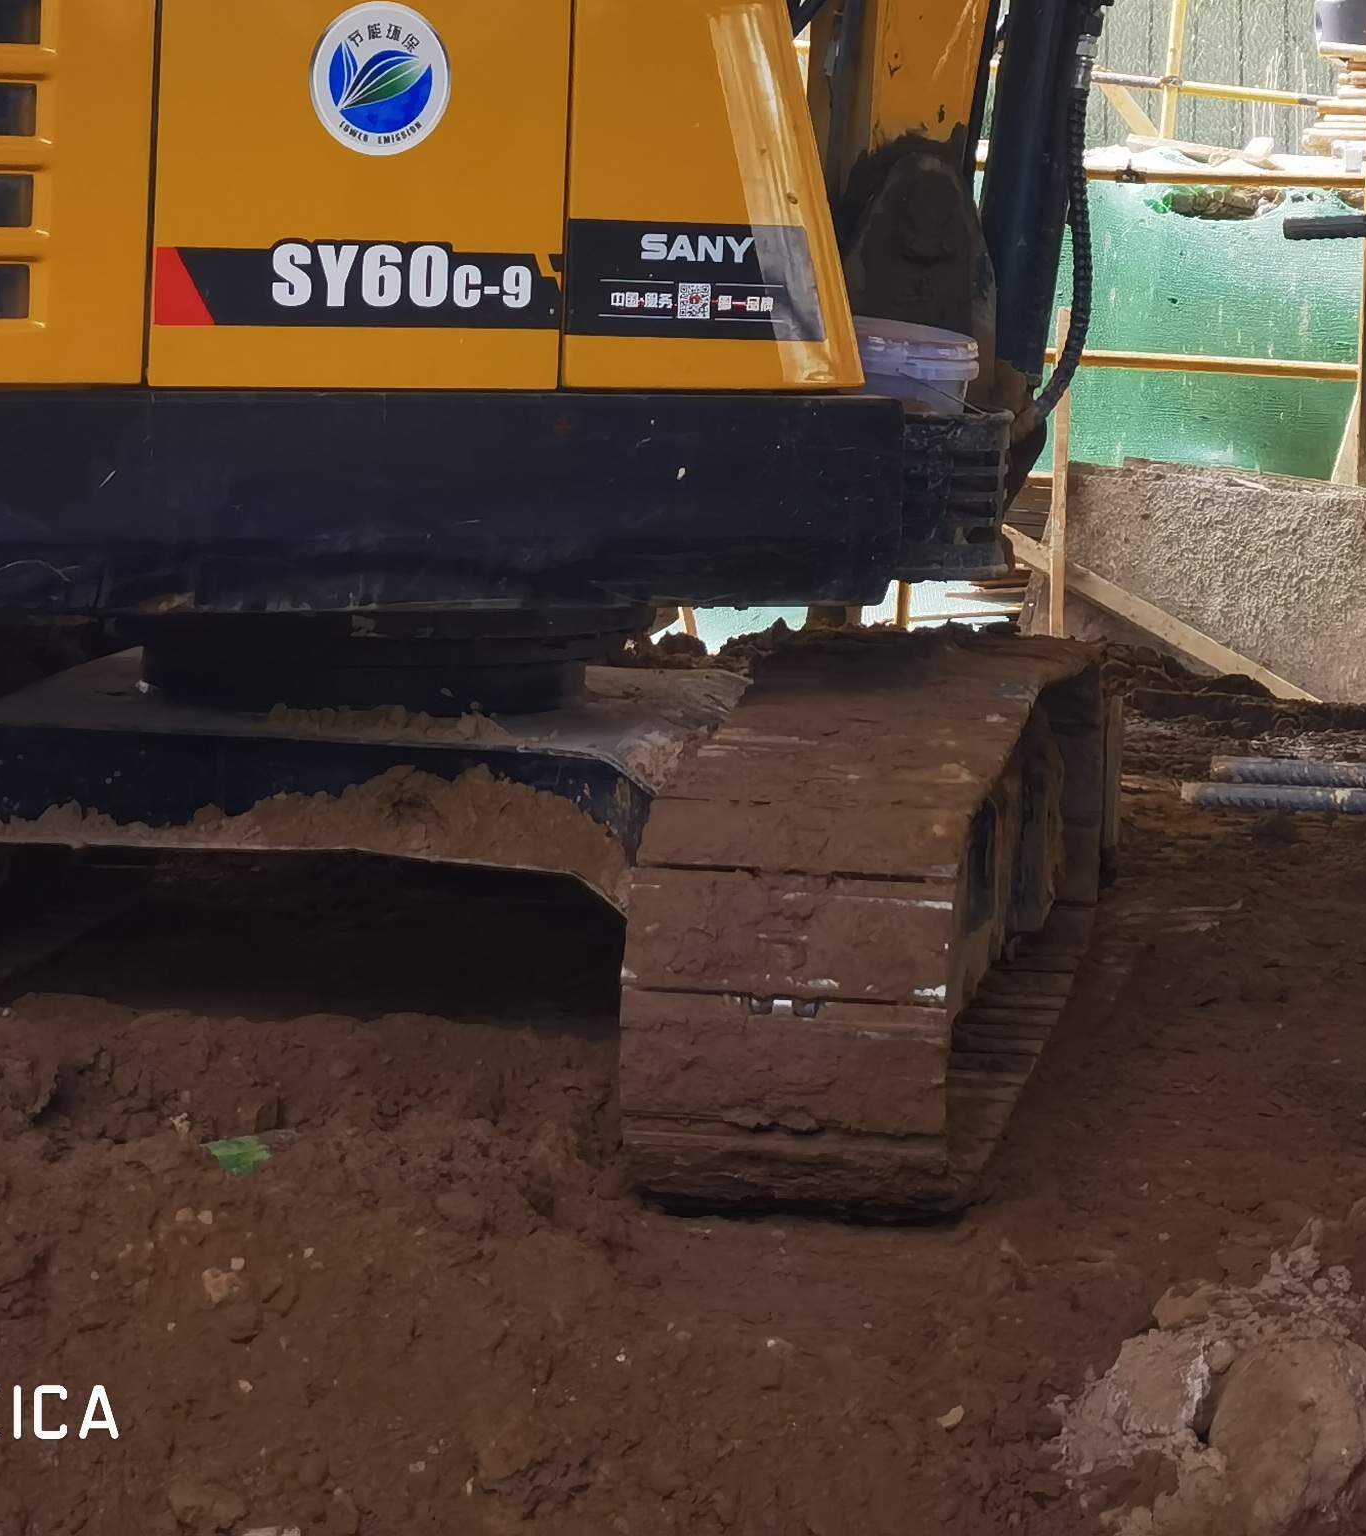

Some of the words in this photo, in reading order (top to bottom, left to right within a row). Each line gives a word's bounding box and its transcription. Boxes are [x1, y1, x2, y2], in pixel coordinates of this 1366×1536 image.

[347, 23, 421, 52] 节能环保
[339, 120, 369, 143] LOWER
[377, 120, 423, 145] EMISSION
[640, 233, 755, 264] SANY
